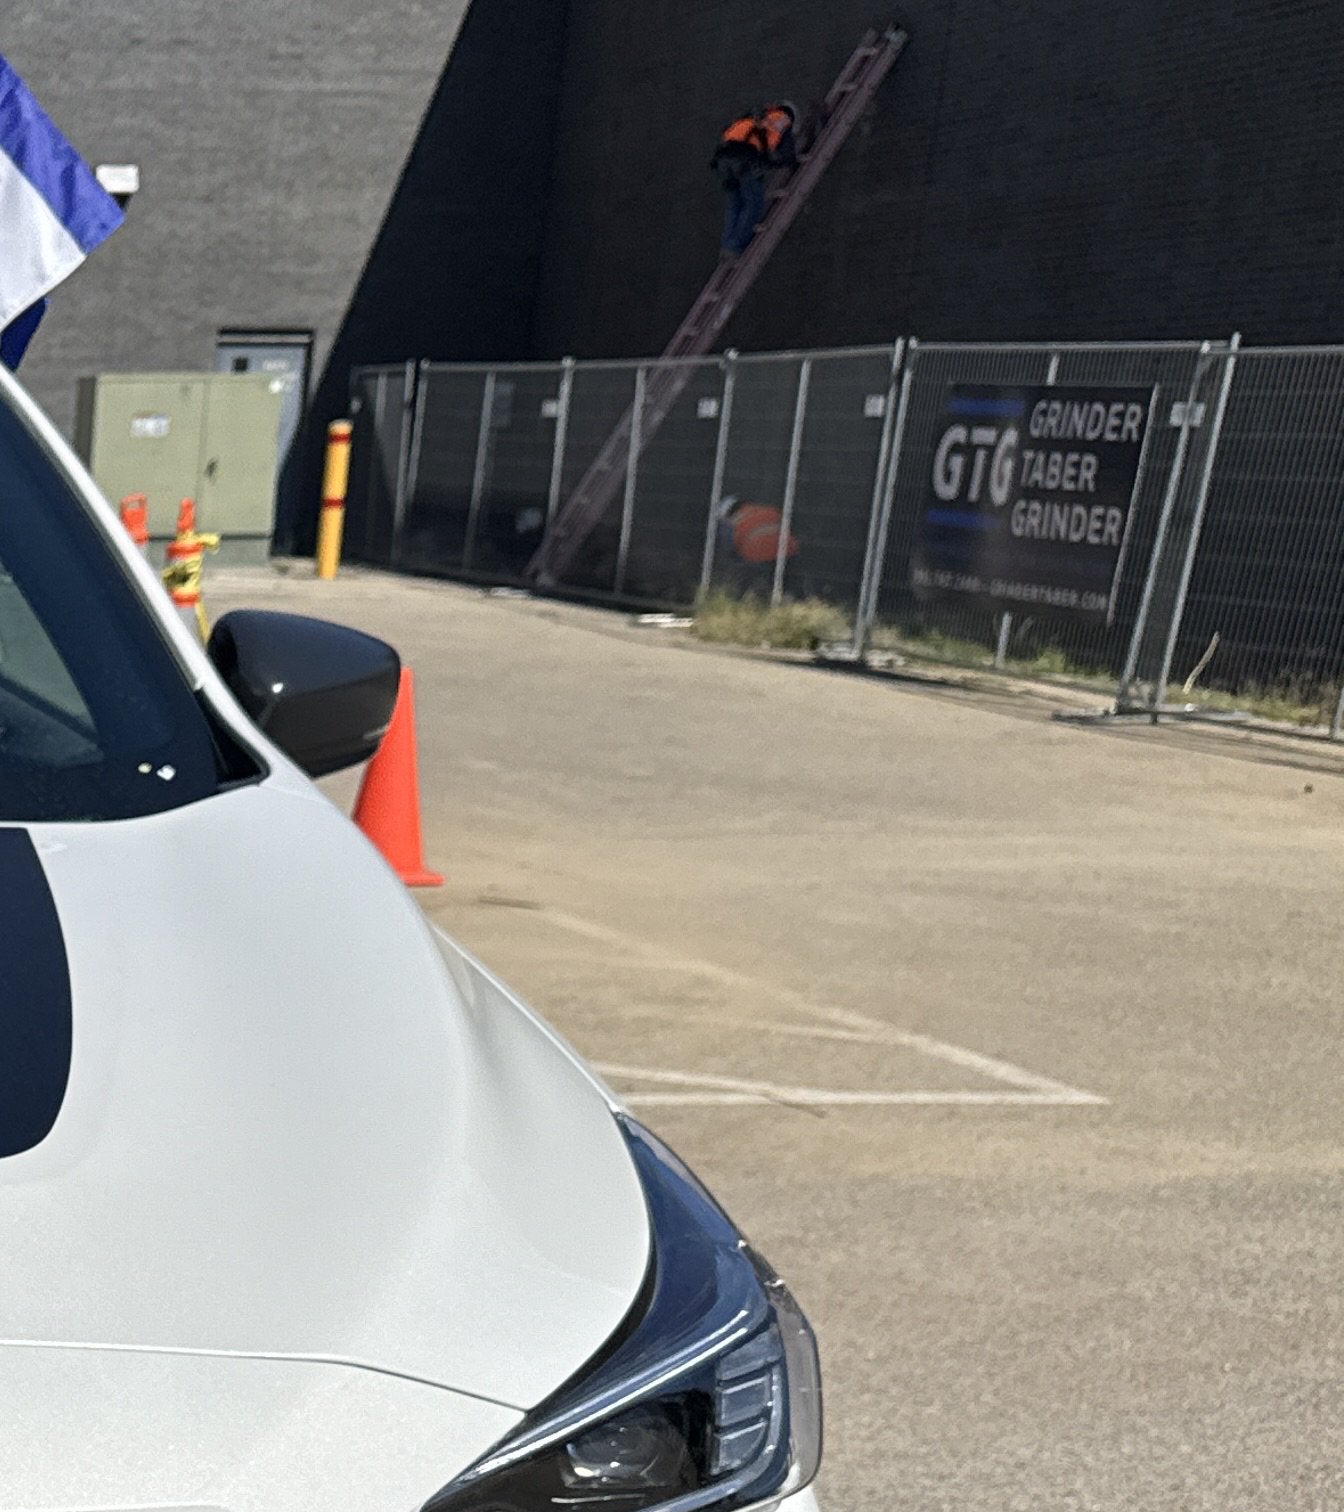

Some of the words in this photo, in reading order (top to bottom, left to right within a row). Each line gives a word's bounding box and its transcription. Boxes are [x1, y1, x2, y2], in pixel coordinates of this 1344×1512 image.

[1029, 400, 1142, 442] GRINDER
[933, 424, 1018, 506] GTG
[1020, 450, 1099, 492] TABER
[1011, 500, 1122, 545] GRINDER
